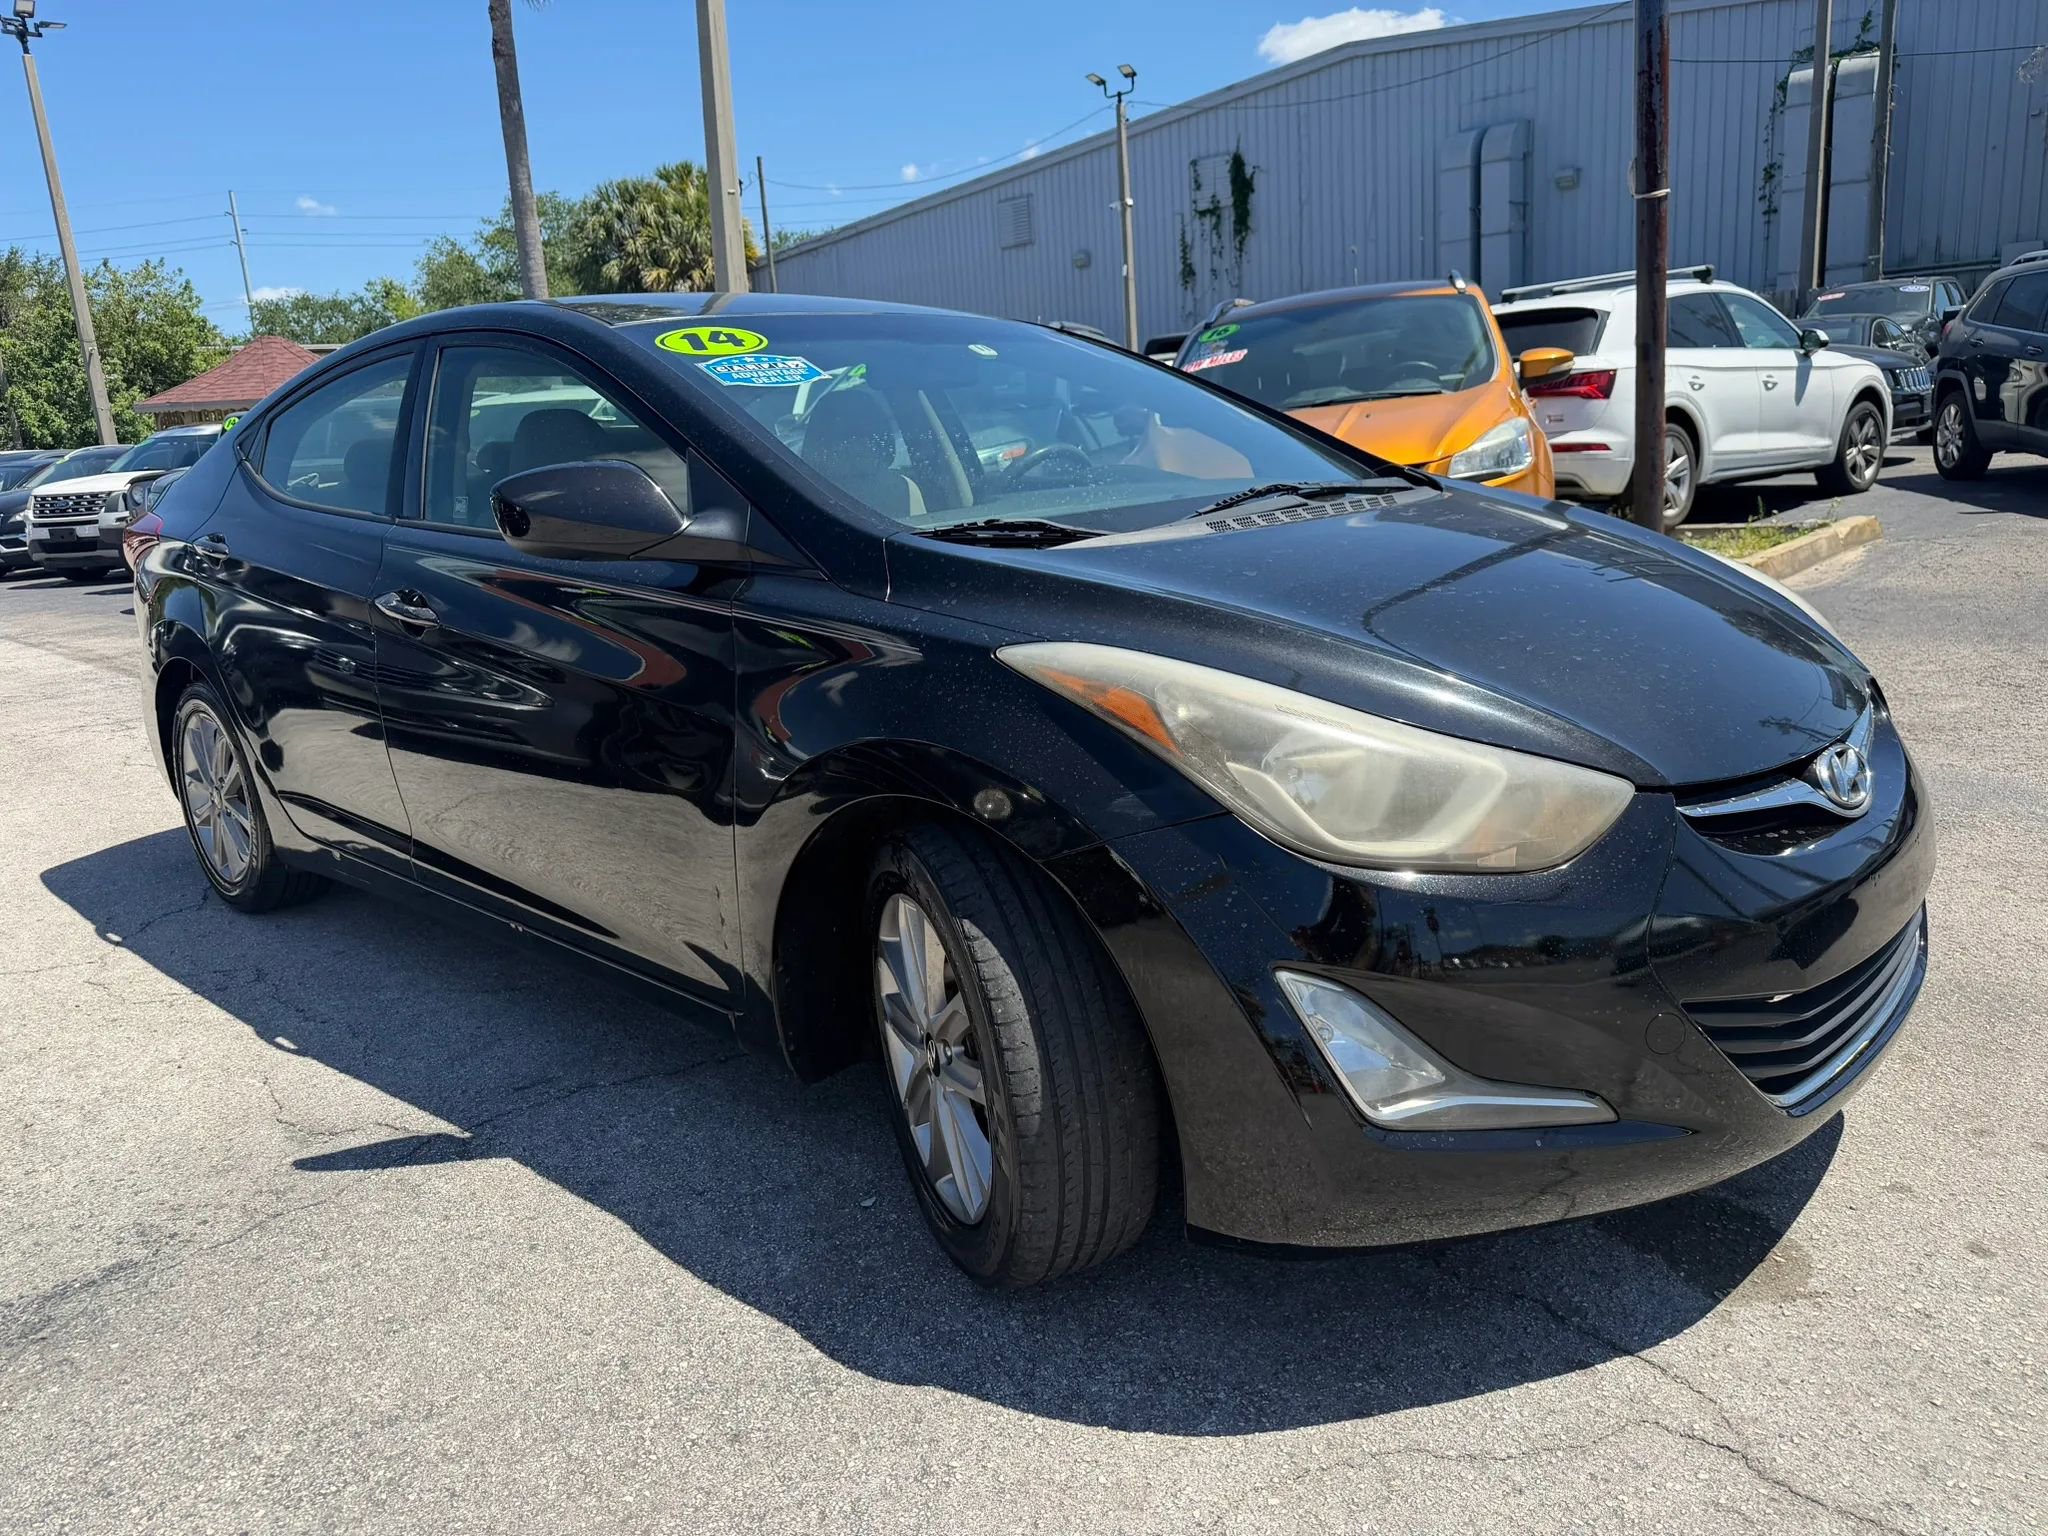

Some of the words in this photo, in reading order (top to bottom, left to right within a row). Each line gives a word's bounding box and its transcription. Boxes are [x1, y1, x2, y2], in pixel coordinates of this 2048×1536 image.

[680, 330, 746, 351] 14
[731, 368, 808, 379] ADVANTAGE
[752, 375, 805, 384] DEALER
